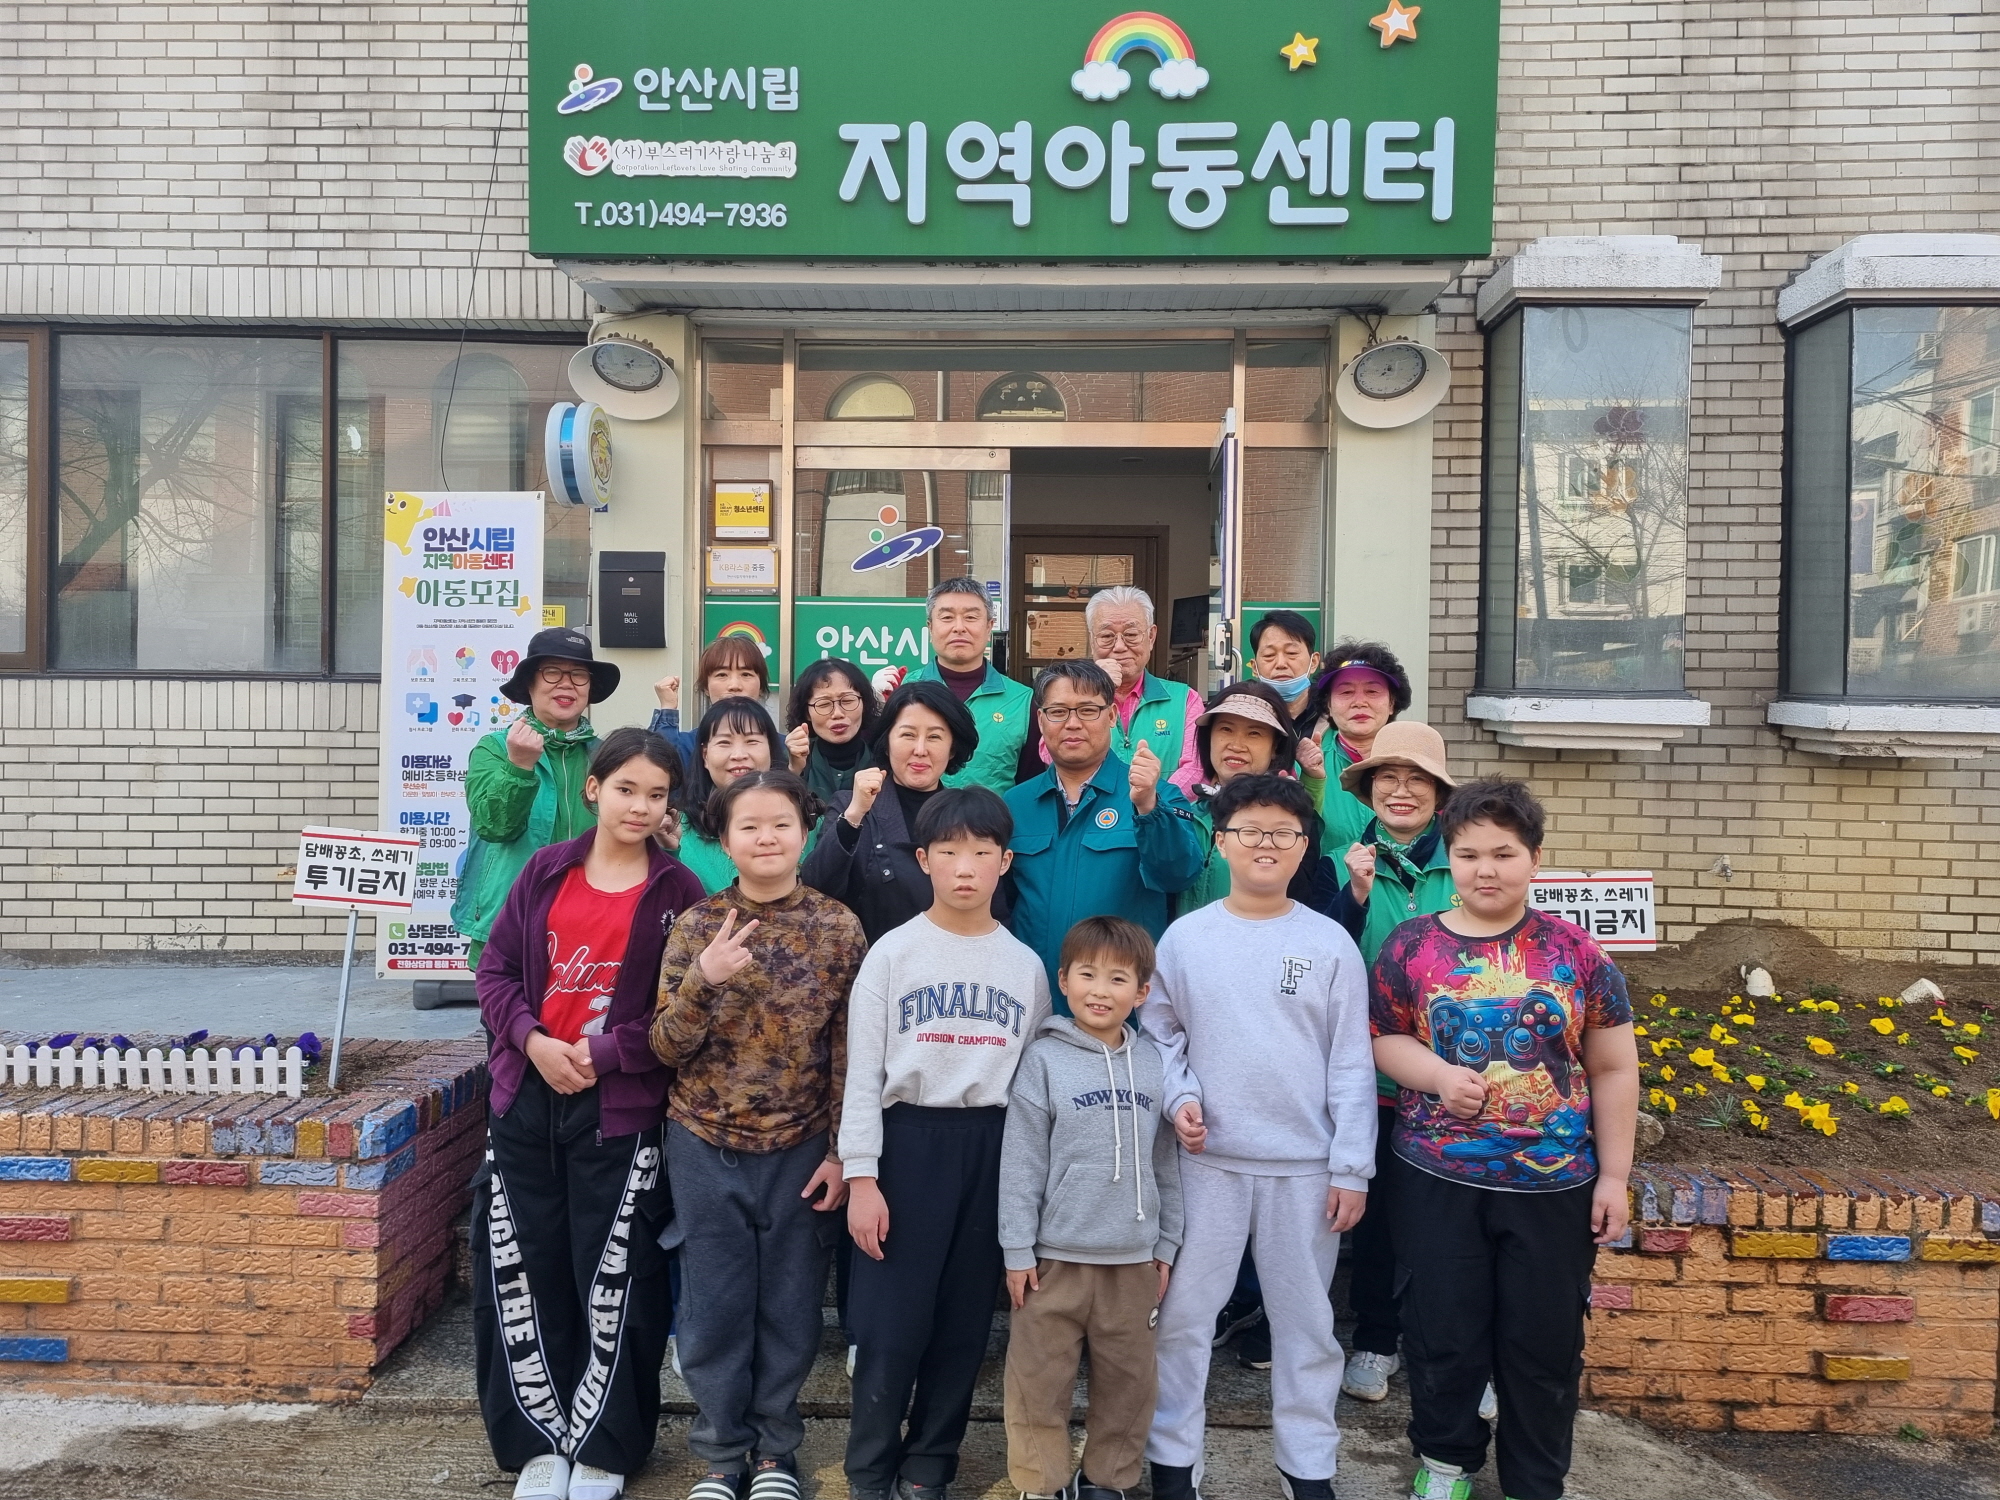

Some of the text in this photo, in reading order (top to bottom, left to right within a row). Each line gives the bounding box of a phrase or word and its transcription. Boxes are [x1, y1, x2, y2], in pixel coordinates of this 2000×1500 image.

[633, 66, 799, 112] 안산시립
[614, 144, 792, 164] (사)부스러기사랑나눔회
[616, 163, 792, 174] Corporation Leftovers Love Sharing Community
[838, 116, 1456, 231] 지역아동센터
[574, 199, 788, 229] T.031)494-7936
[733, 505, 765, 513] 청소년센터
[422, 527, 515, 552] 안산시립
[422, 553, 514, 570] 지역아동센터
[416, 579, 520, 607] 아동모집
[815, 625, 929, 665] 안산시
[401, 755, 453, 769] 이용대상
[399, 811, 451, 826] 이용시간
[430, 827, 456, 837] 10:00
[429, 839, 457, 848] 09:00
[305, 843, 413, 865] 담배꽁초, 쓰레기
[305, 864, 407, 897] 투기금지
[420, 878, 438, 888] 방문
[414, 889, 436, 900] 예약
[437, 889, 447, 900] 후
[1533, 887, 1649, 903] 담배꽁초, 쓰레기
[388, 942, 471, 956] 031-494-7
[899, 981, 1026, 1037] FINALIST
[916, 1033, 1007, 1047] DIVISION CHAMPIONS
[1072, 1089, 1154, 1112] NEW YORK
[498, 1272, 536, 1346] THE
